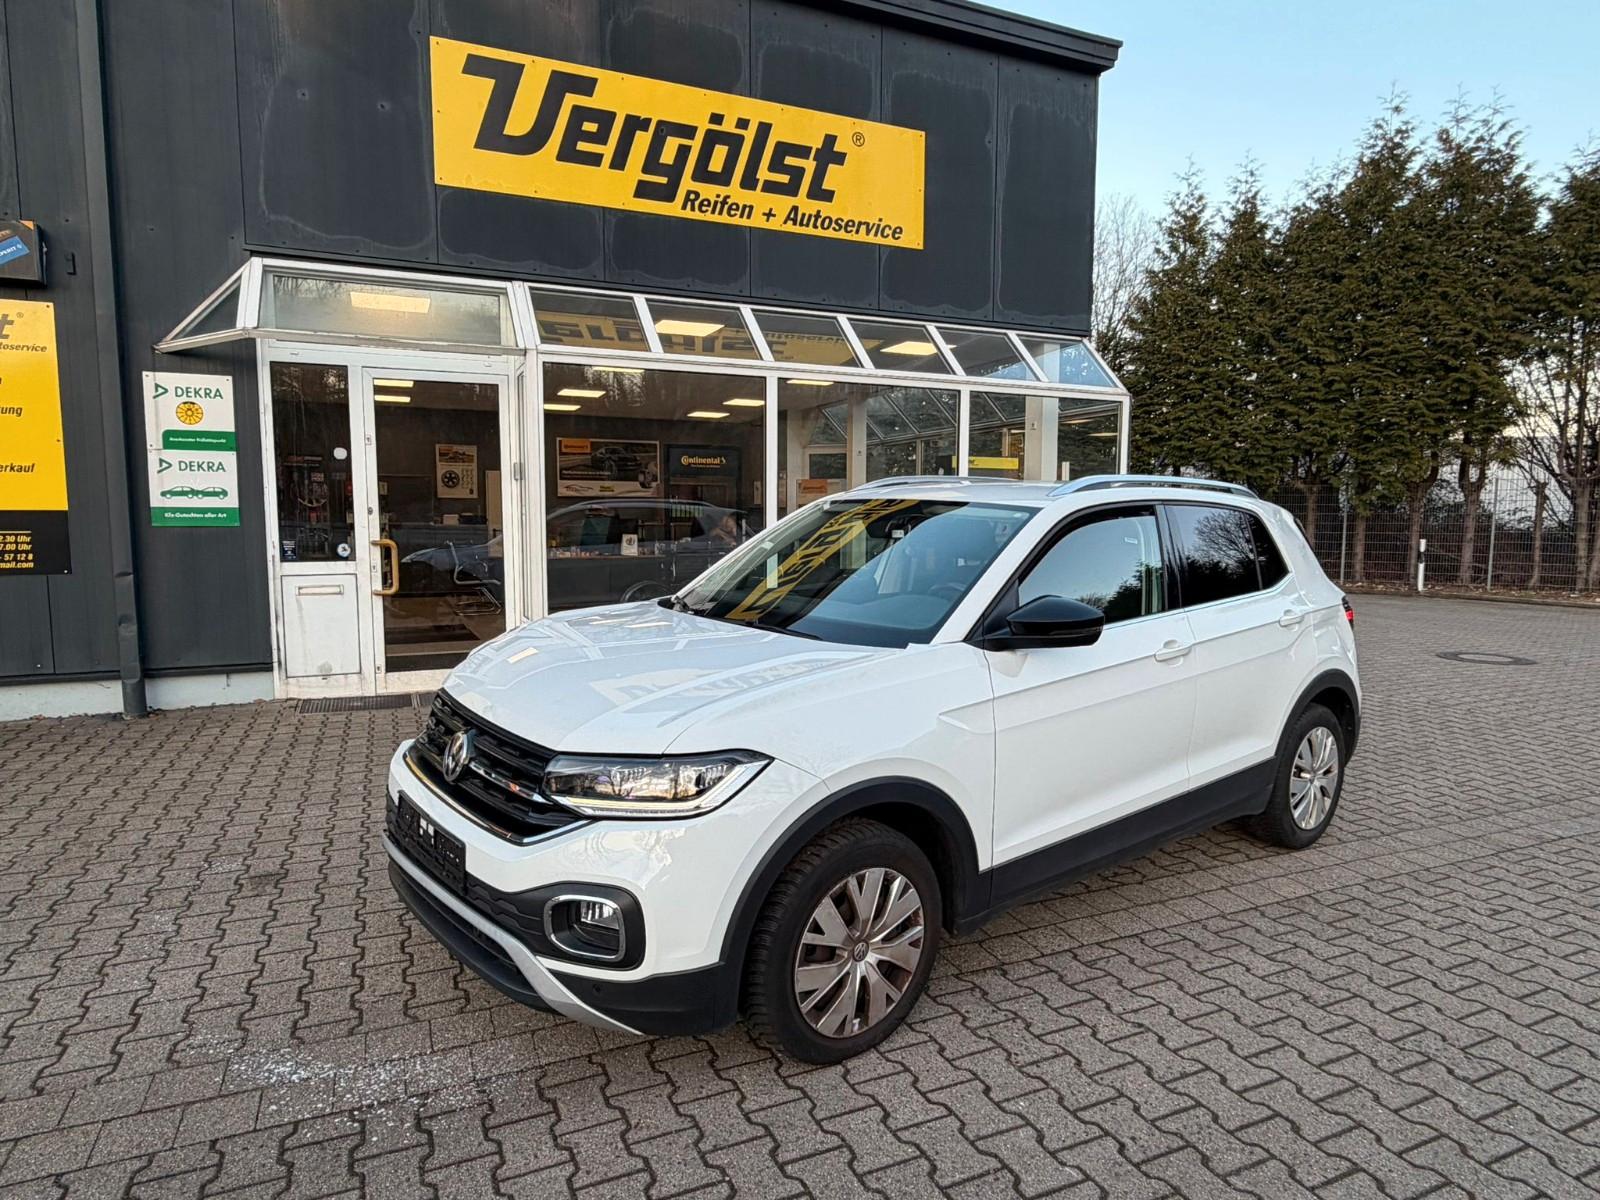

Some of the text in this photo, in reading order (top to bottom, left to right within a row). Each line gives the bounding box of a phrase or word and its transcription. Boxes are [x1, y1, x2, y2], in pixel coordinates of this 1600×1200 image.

[461, 53, 848, 203] Vergölst
[681, 190, 754, 221] Reifen
[783, 203, 904, 241] Autoservice
[174, 386, 224, 400] DEKRA
[0, 406, 23, 417] ung
[178, 460, 227, 473] DEKRA
[17, 535, 32, 543] Uhr
[17, 543, 32, 551] Uhr
